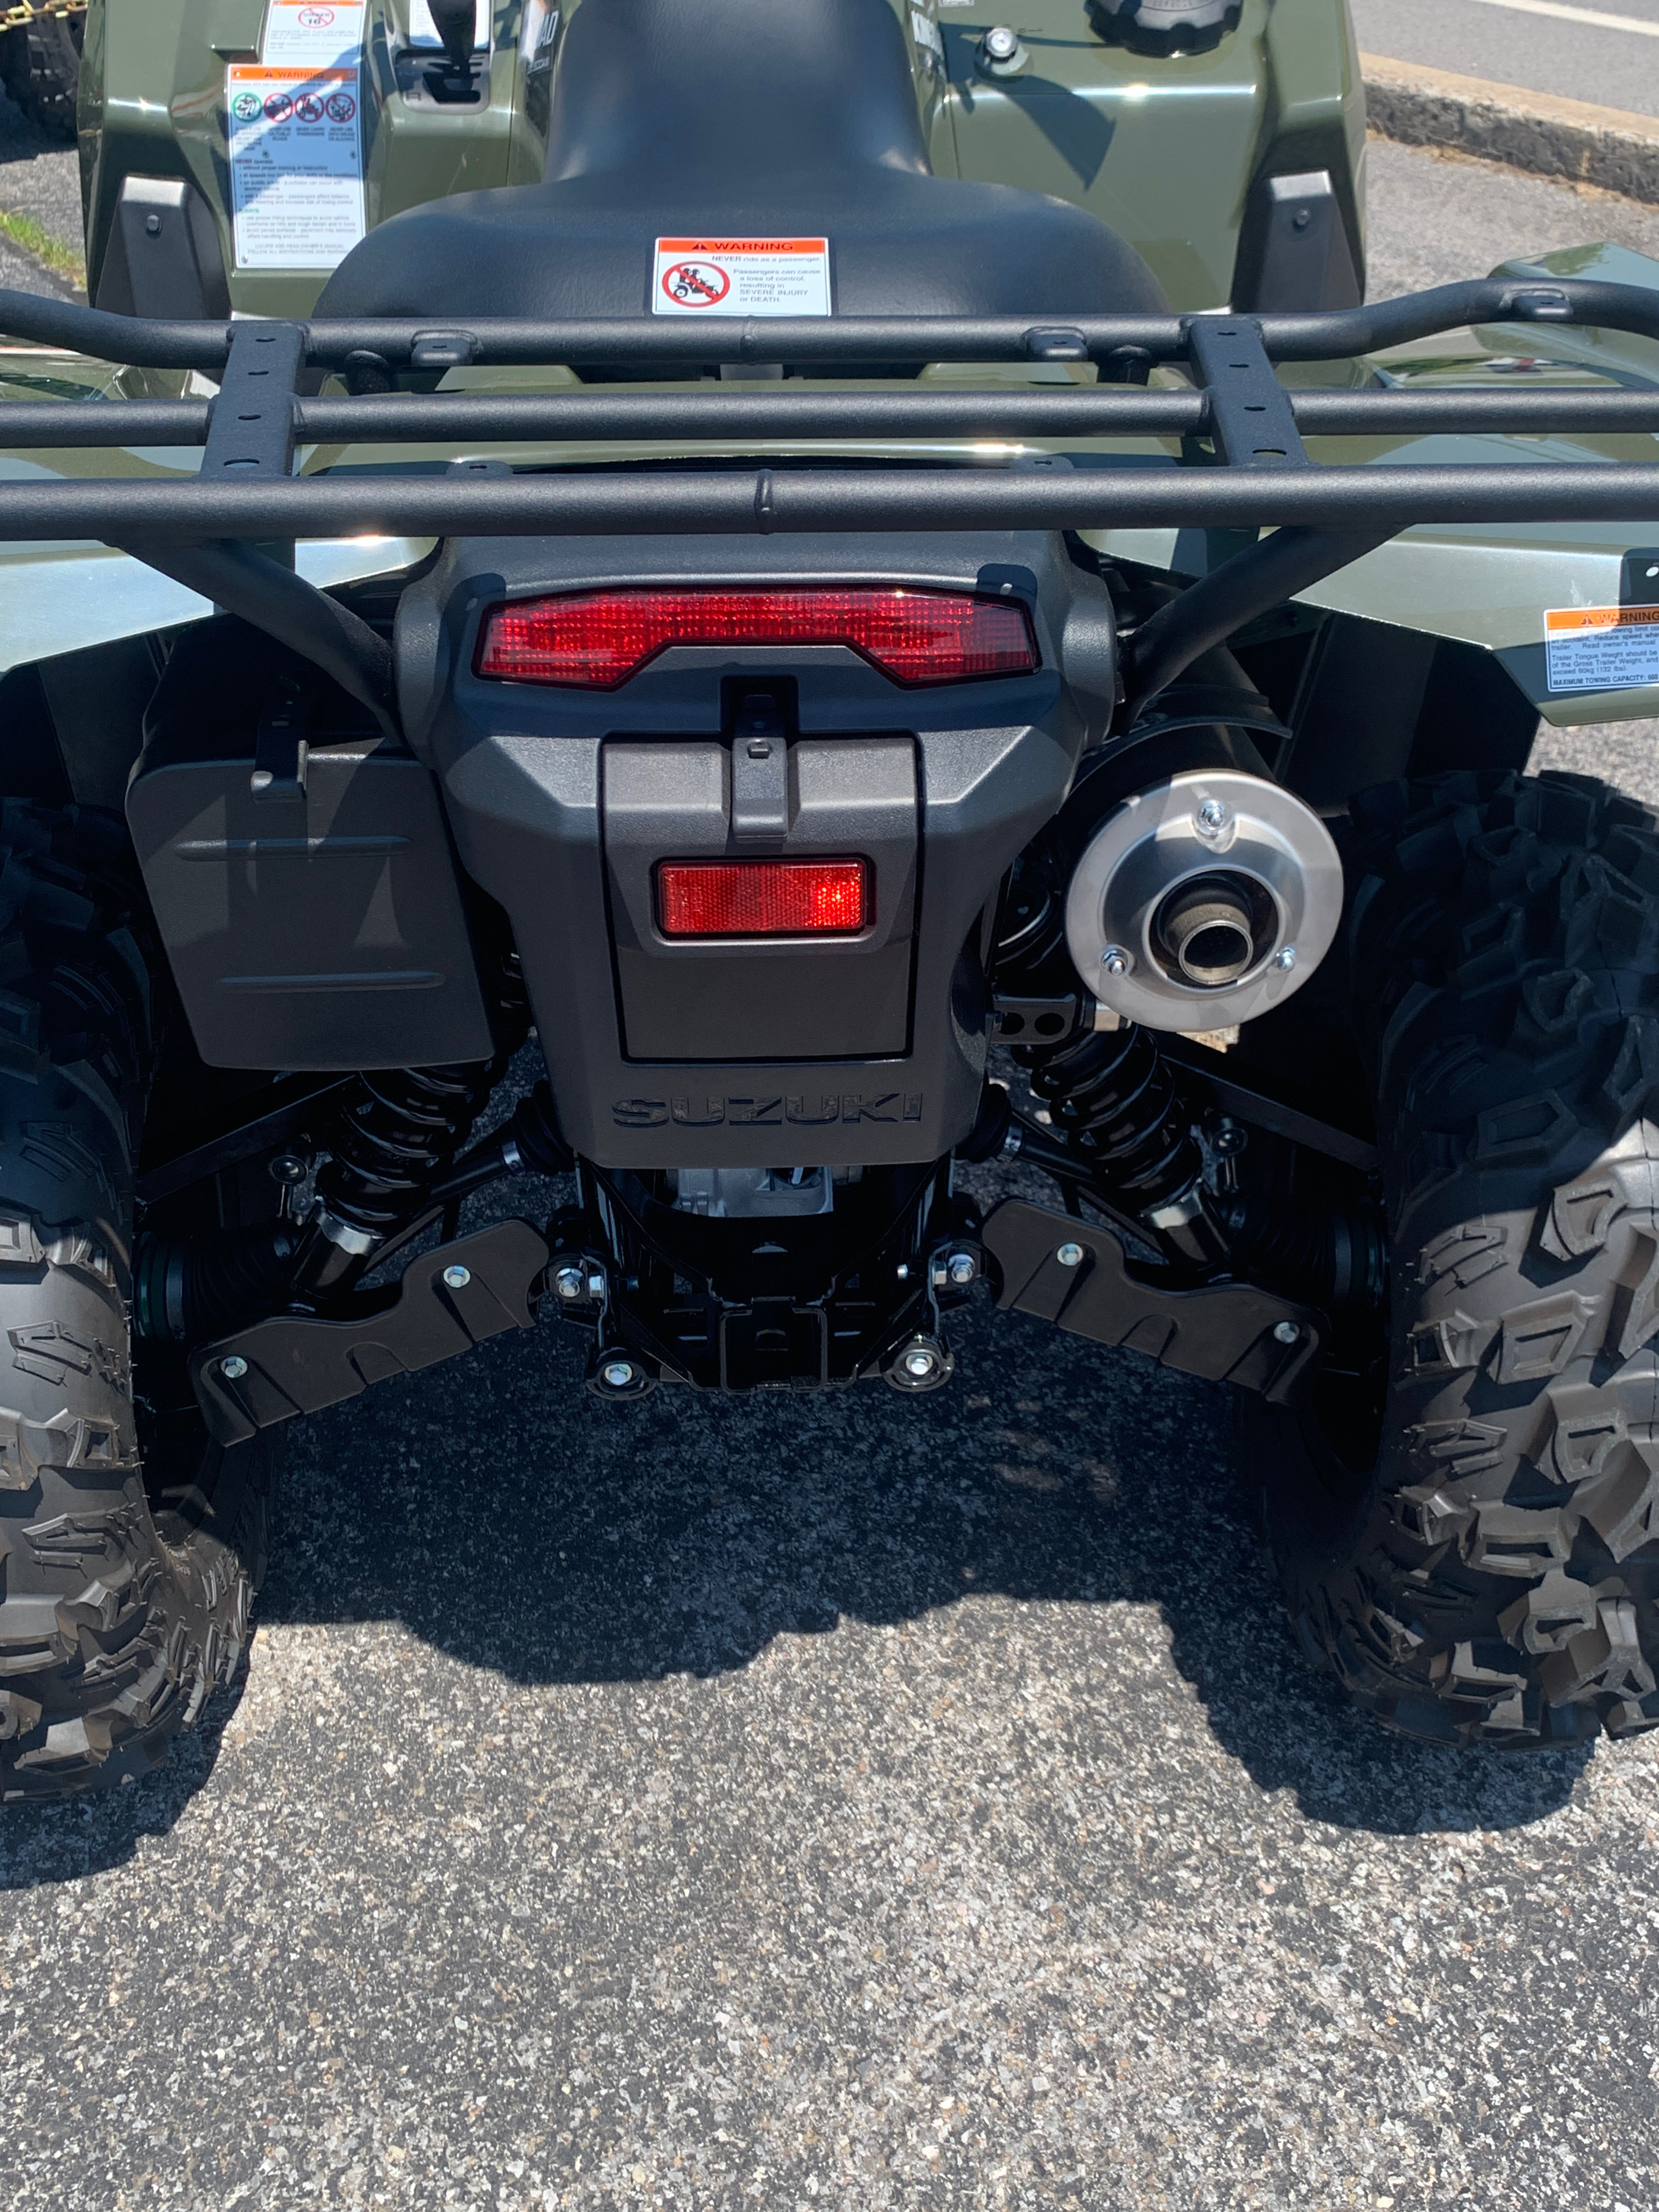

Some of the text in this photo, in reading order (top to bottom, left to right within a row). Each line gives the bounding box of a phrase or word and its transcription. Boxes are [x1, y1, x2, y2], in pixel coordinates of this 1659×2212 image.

[1600, 611, 1659, 623] WARNING
[1613, 674, 1646, 682] CAPACITY:
[612, 1093, 923, 1128] SUZUKI
